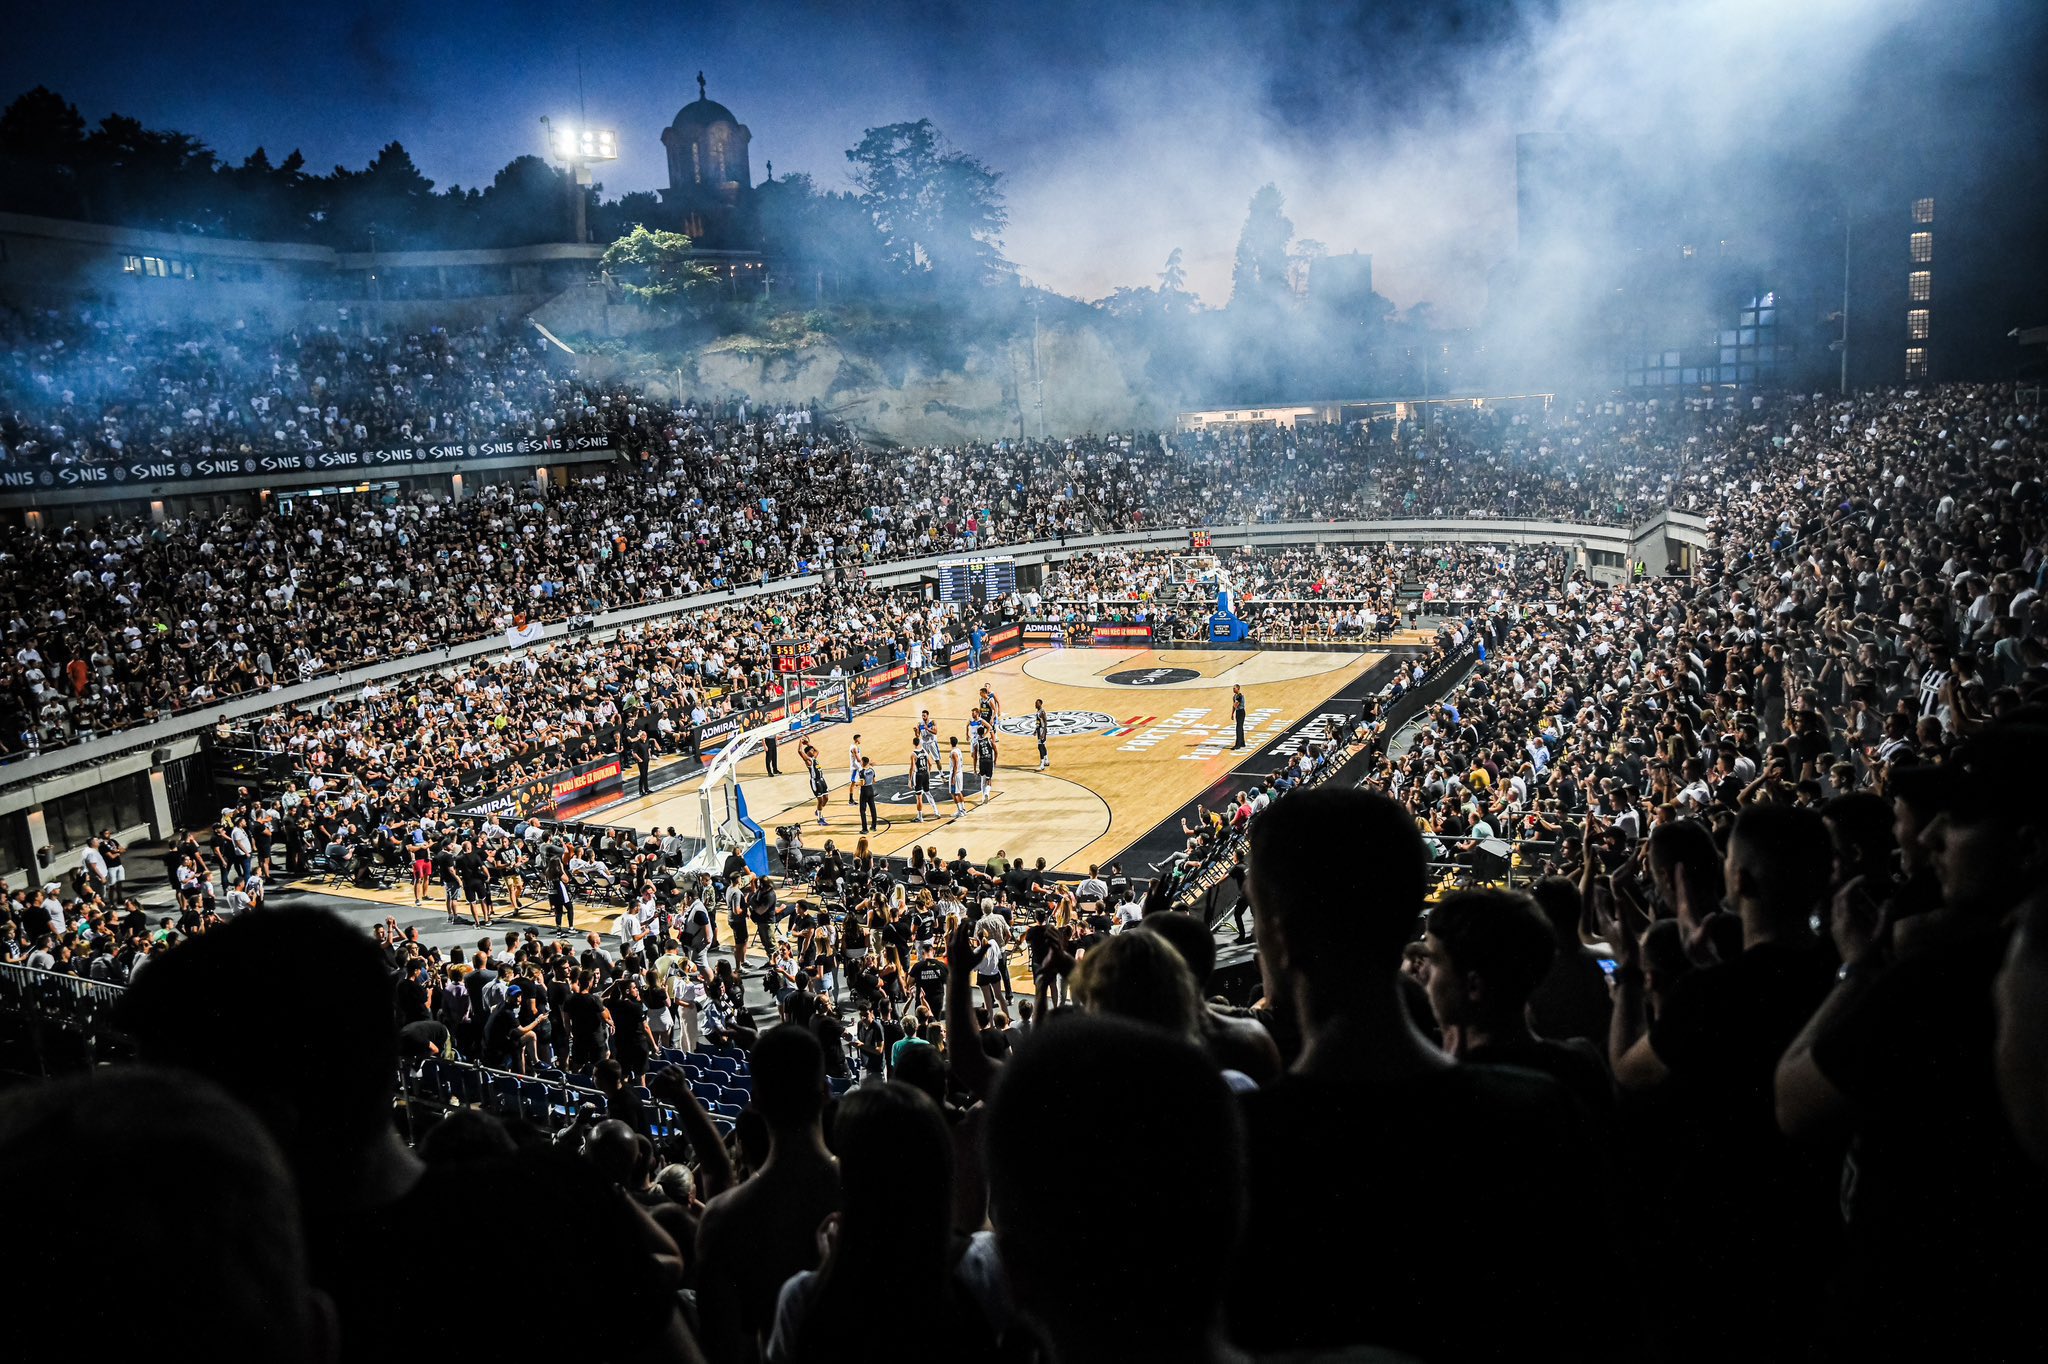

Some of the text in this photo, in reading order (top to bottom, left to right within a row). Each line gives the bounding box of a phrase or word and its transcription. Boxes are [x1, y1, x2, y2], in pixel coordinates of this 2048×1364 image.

[591, 436, 608, 446] NIS
[392, 449, 412, 460] NIS
[444, 446, 464, 457] NIS
[495, 442, 514, 454] NIS
[215, 460, 239, 473] NIS
[278, 456, 300, 469] NIS
[80, 468, 108, 482] NIS
[151, 464, 176, 478] NIS
[4, 472, 34, 486] NIS
[1024, 624, 1064, 632] ADMIRAL
[776, 646, 794, 655] 3:53
[780, 658, 796, 672] 24
[800, 656, 811, 670] 24
[700, 718, 740, 740] ADMIRAL
[1116, 708, 1212, 751] PARTIZAN
